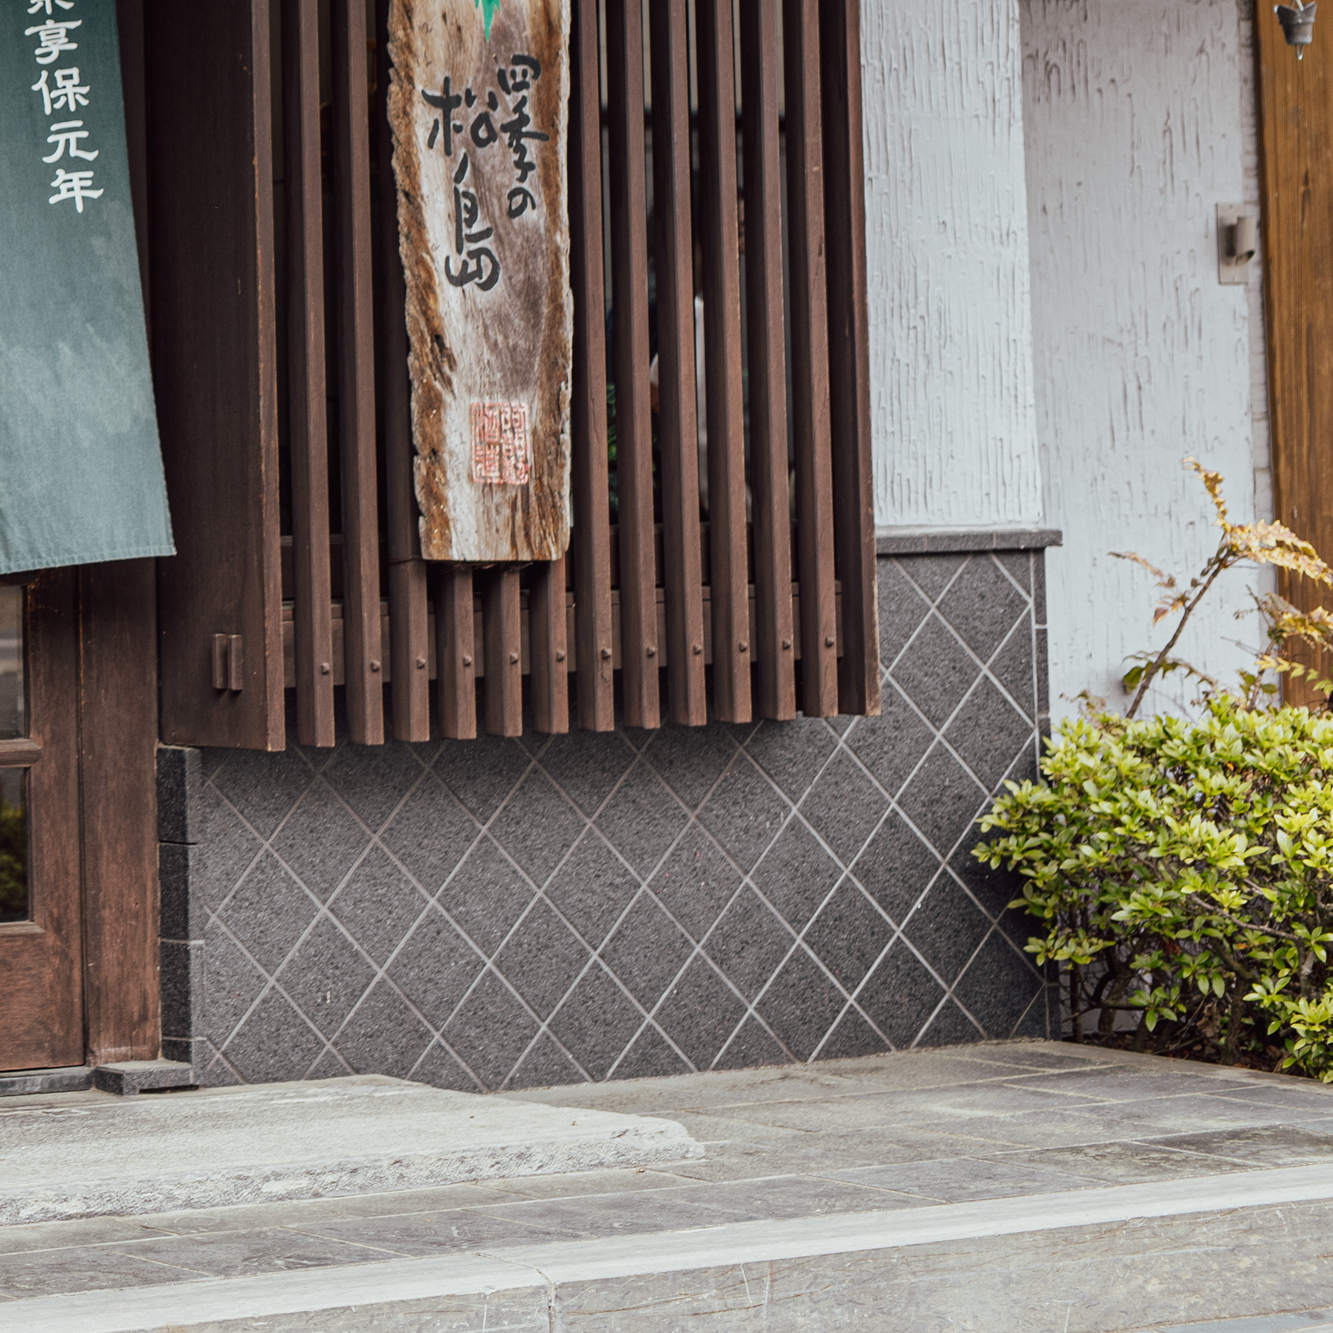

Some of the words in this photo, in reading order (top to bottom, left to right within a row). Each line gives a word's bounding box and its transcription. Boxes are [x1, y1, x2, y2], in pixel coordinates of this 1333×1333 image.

[421, 75, 500, 291] 松島
[497, 54, 550, 219] 四季の
